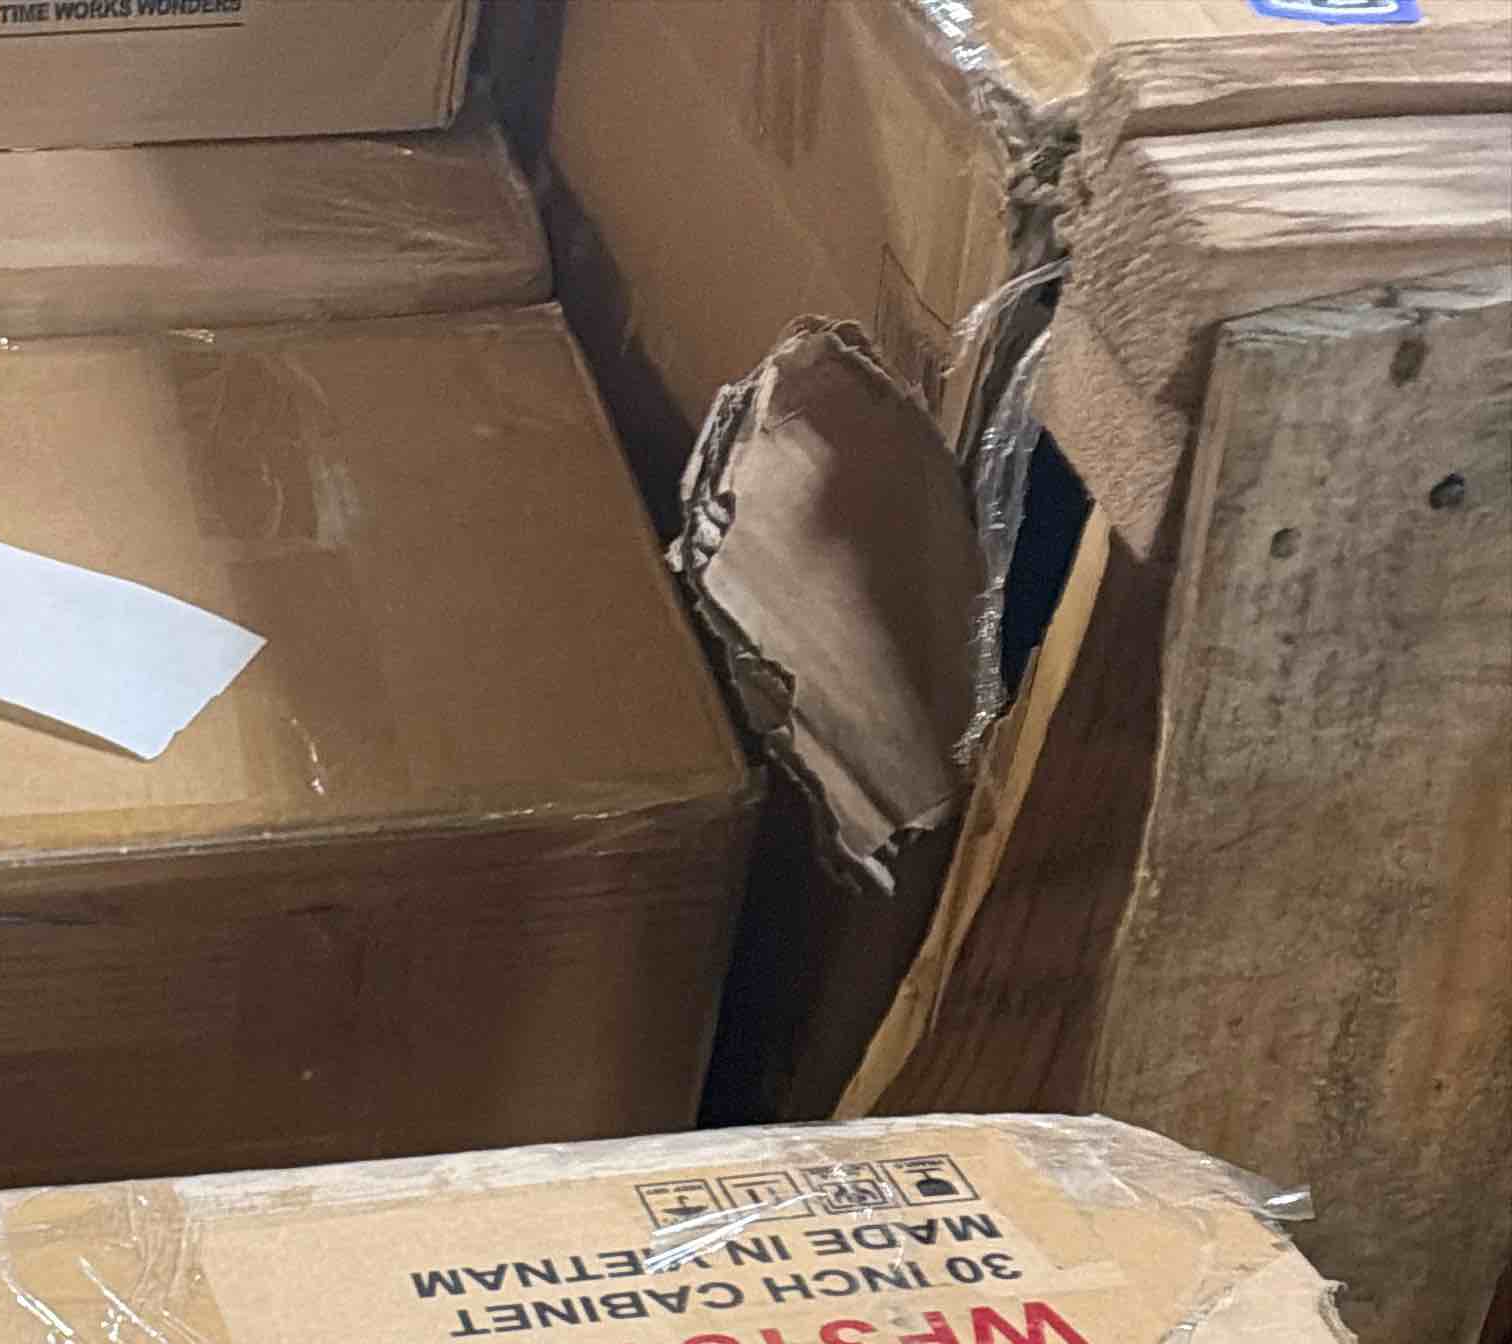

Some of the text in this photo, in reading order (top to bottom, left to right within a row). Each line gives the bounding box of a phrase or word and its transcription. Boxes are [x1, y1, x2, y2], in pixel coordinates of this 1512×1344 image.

[55, 0, 133, 21] WORKS
[726, 1235, 793, 1266] IN
[805, 1212, 1005, 1255] MADE
[450, 1252, 1023, 1338] 30 INCH CABINET
